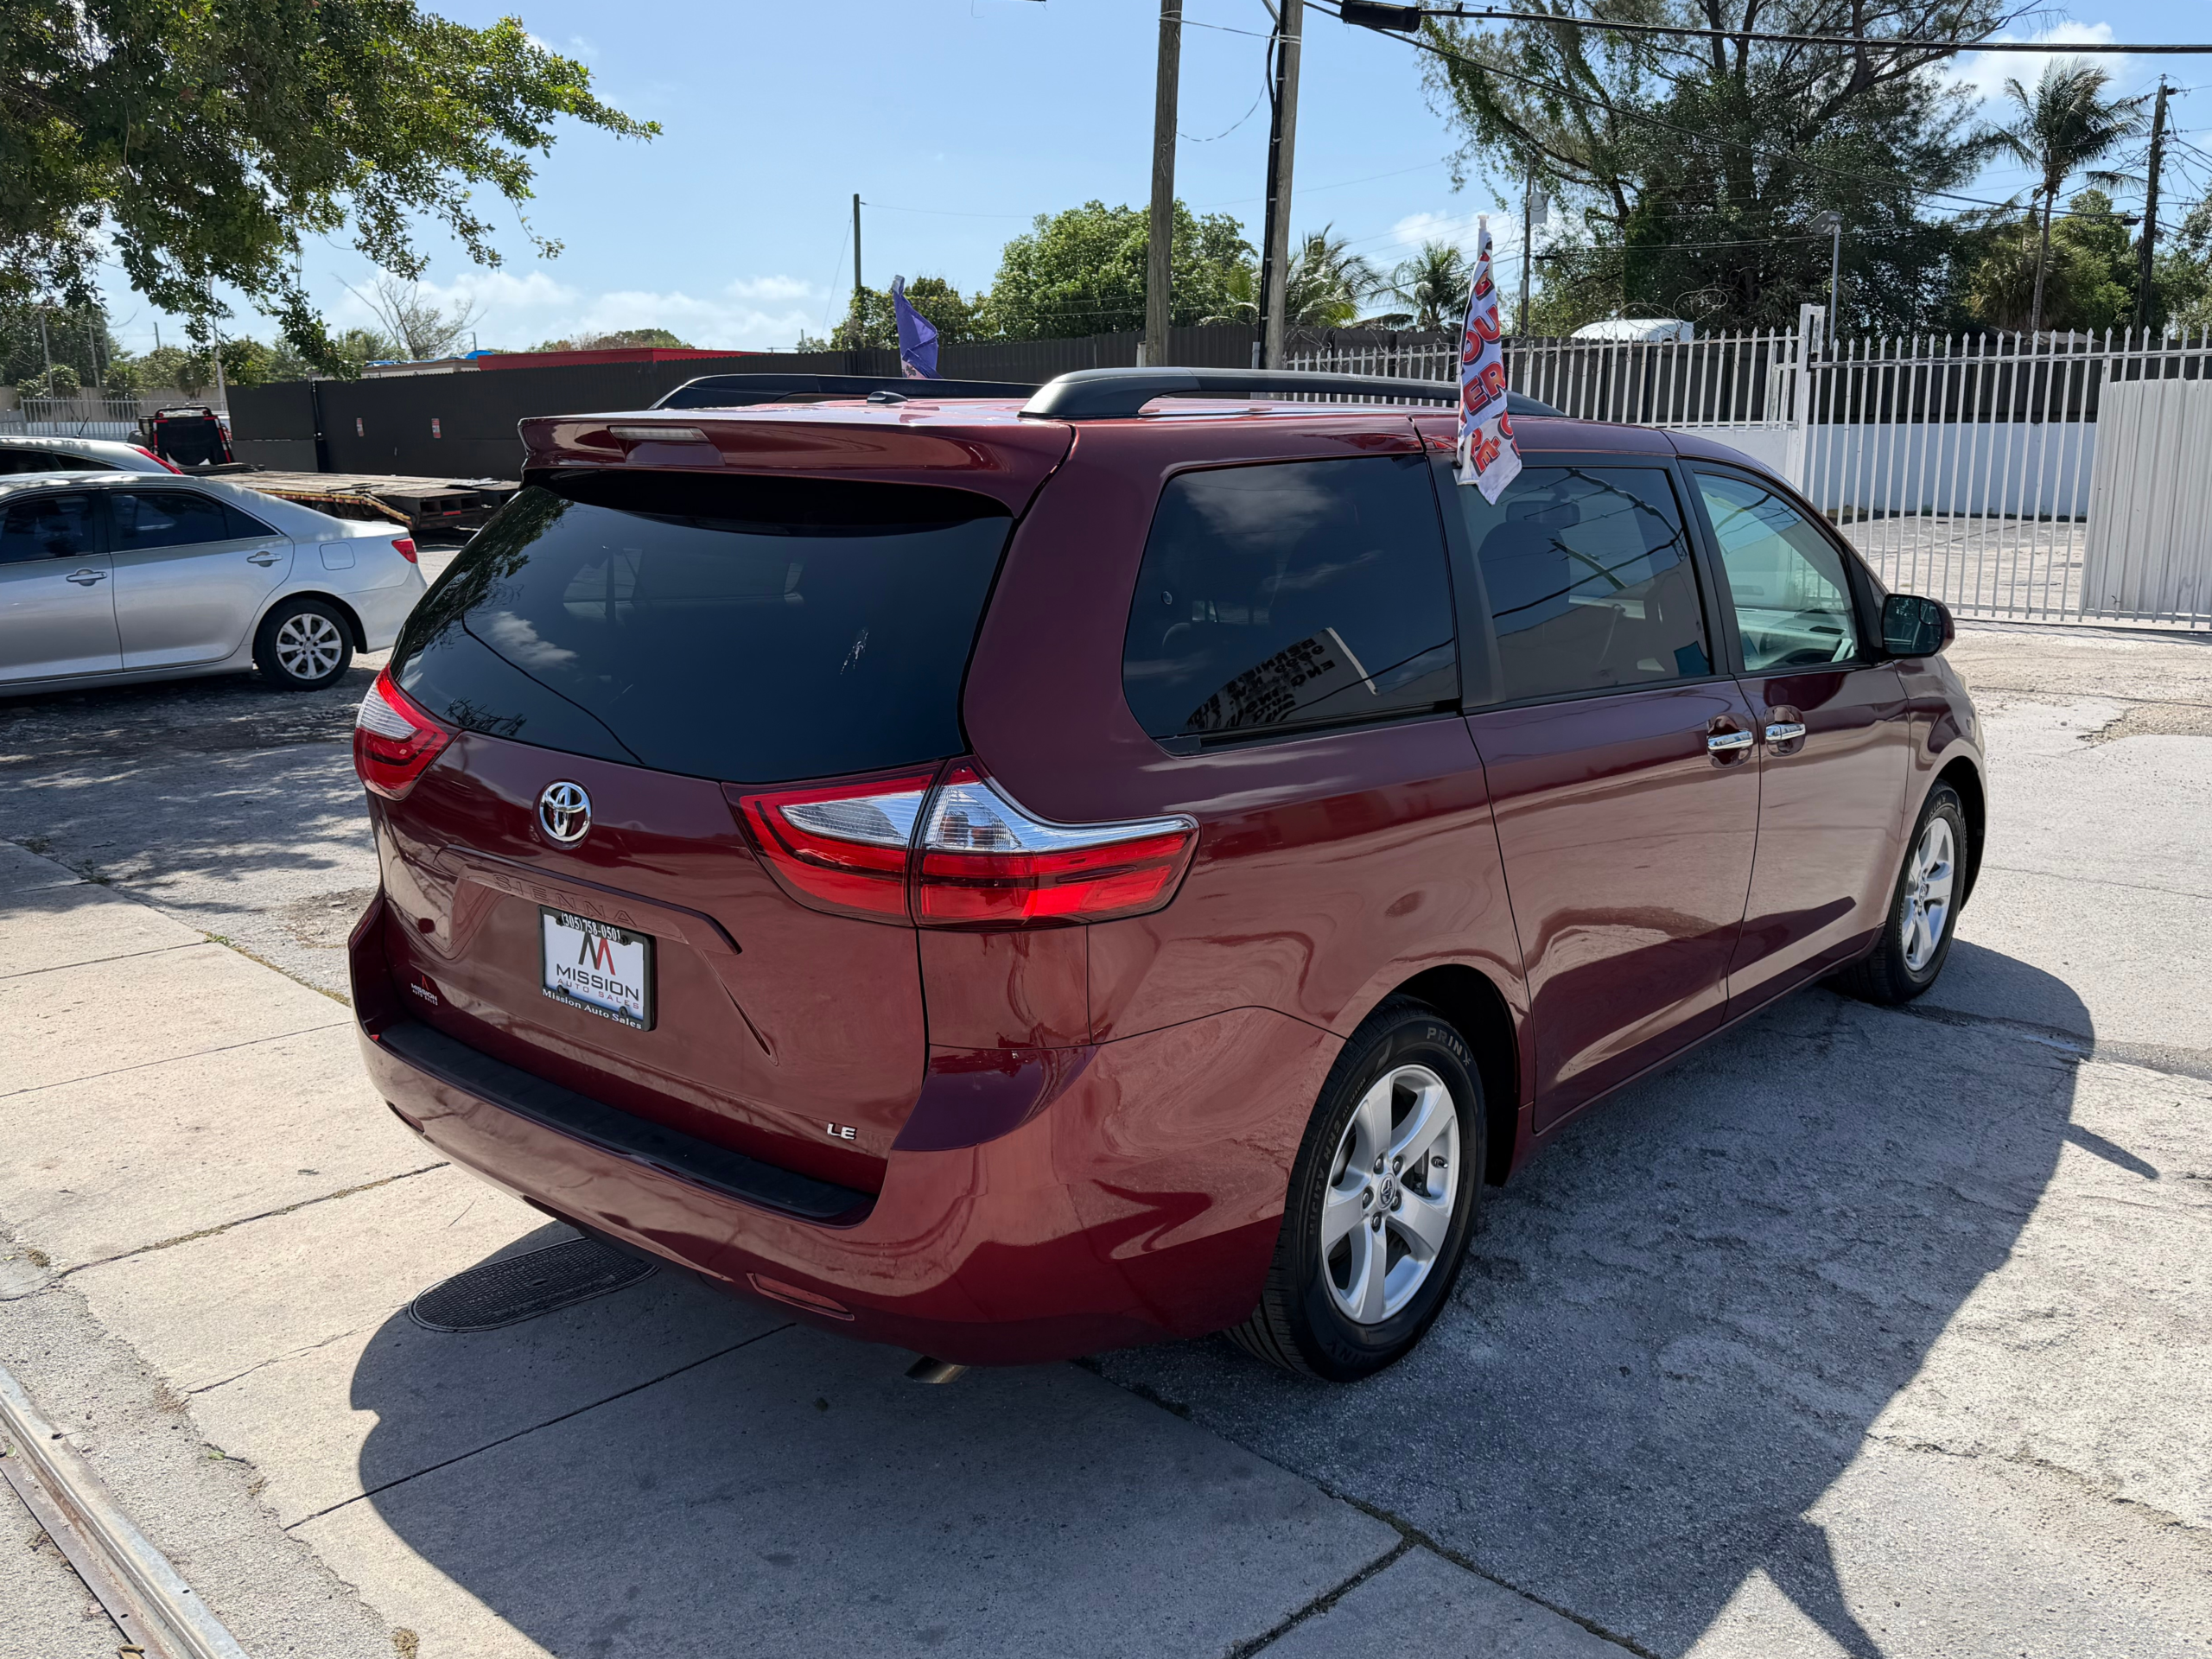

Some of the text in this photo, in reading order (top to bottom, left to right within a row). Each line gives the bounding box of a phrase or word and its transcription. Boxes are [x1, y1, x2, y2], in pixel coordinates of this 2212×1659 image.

[493, 874, 638, 928] SIENNA
[556, 963, 639, 1001] MISSION
[557, 978, 639, 1009] AUTO SALES
[543, 988, 642, 1030] Mission Auto Sales
[1427, 1027, 1472, 1066] PRINX
[827, 1123, 856, 1140] LE
